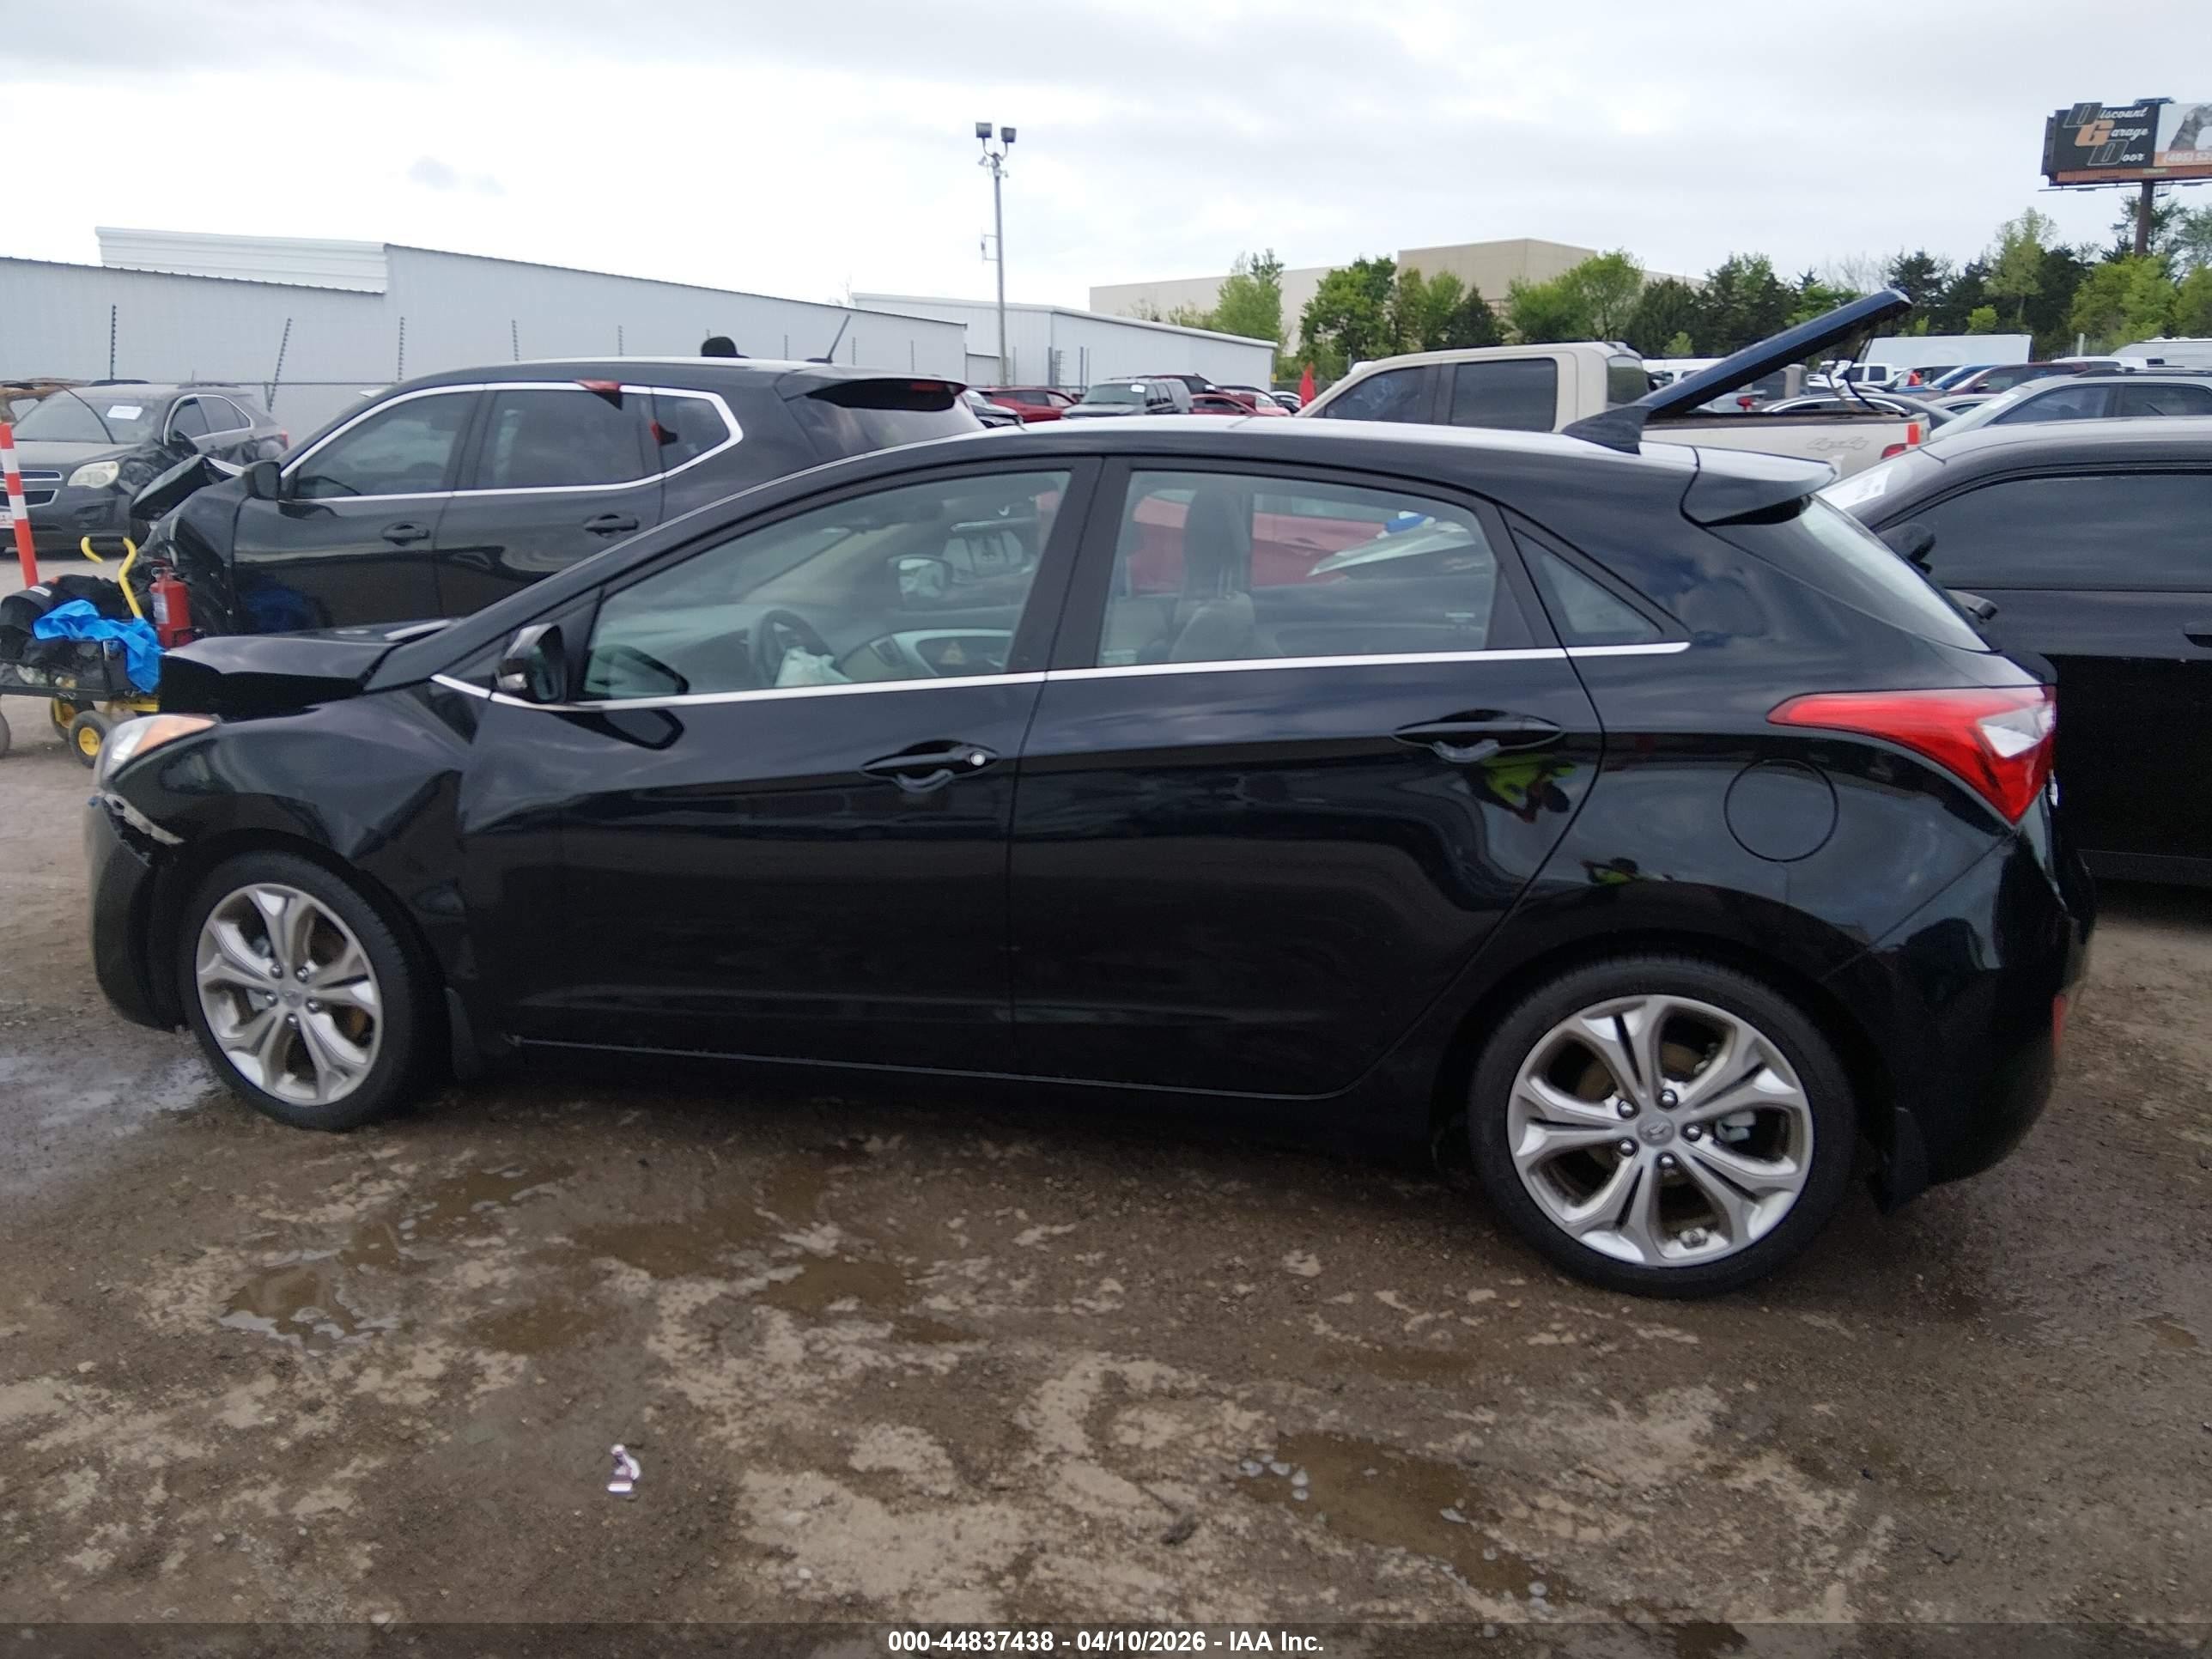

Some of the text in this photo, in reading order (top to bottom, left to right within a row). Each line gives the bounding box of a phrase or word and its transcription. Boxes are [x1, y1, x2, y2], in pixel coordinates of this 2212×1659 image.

[2063, 102, 2149, 128] Discount
[2074, 118, 2149, 147] Garage
[2087, 139, 2146, 166] Door
